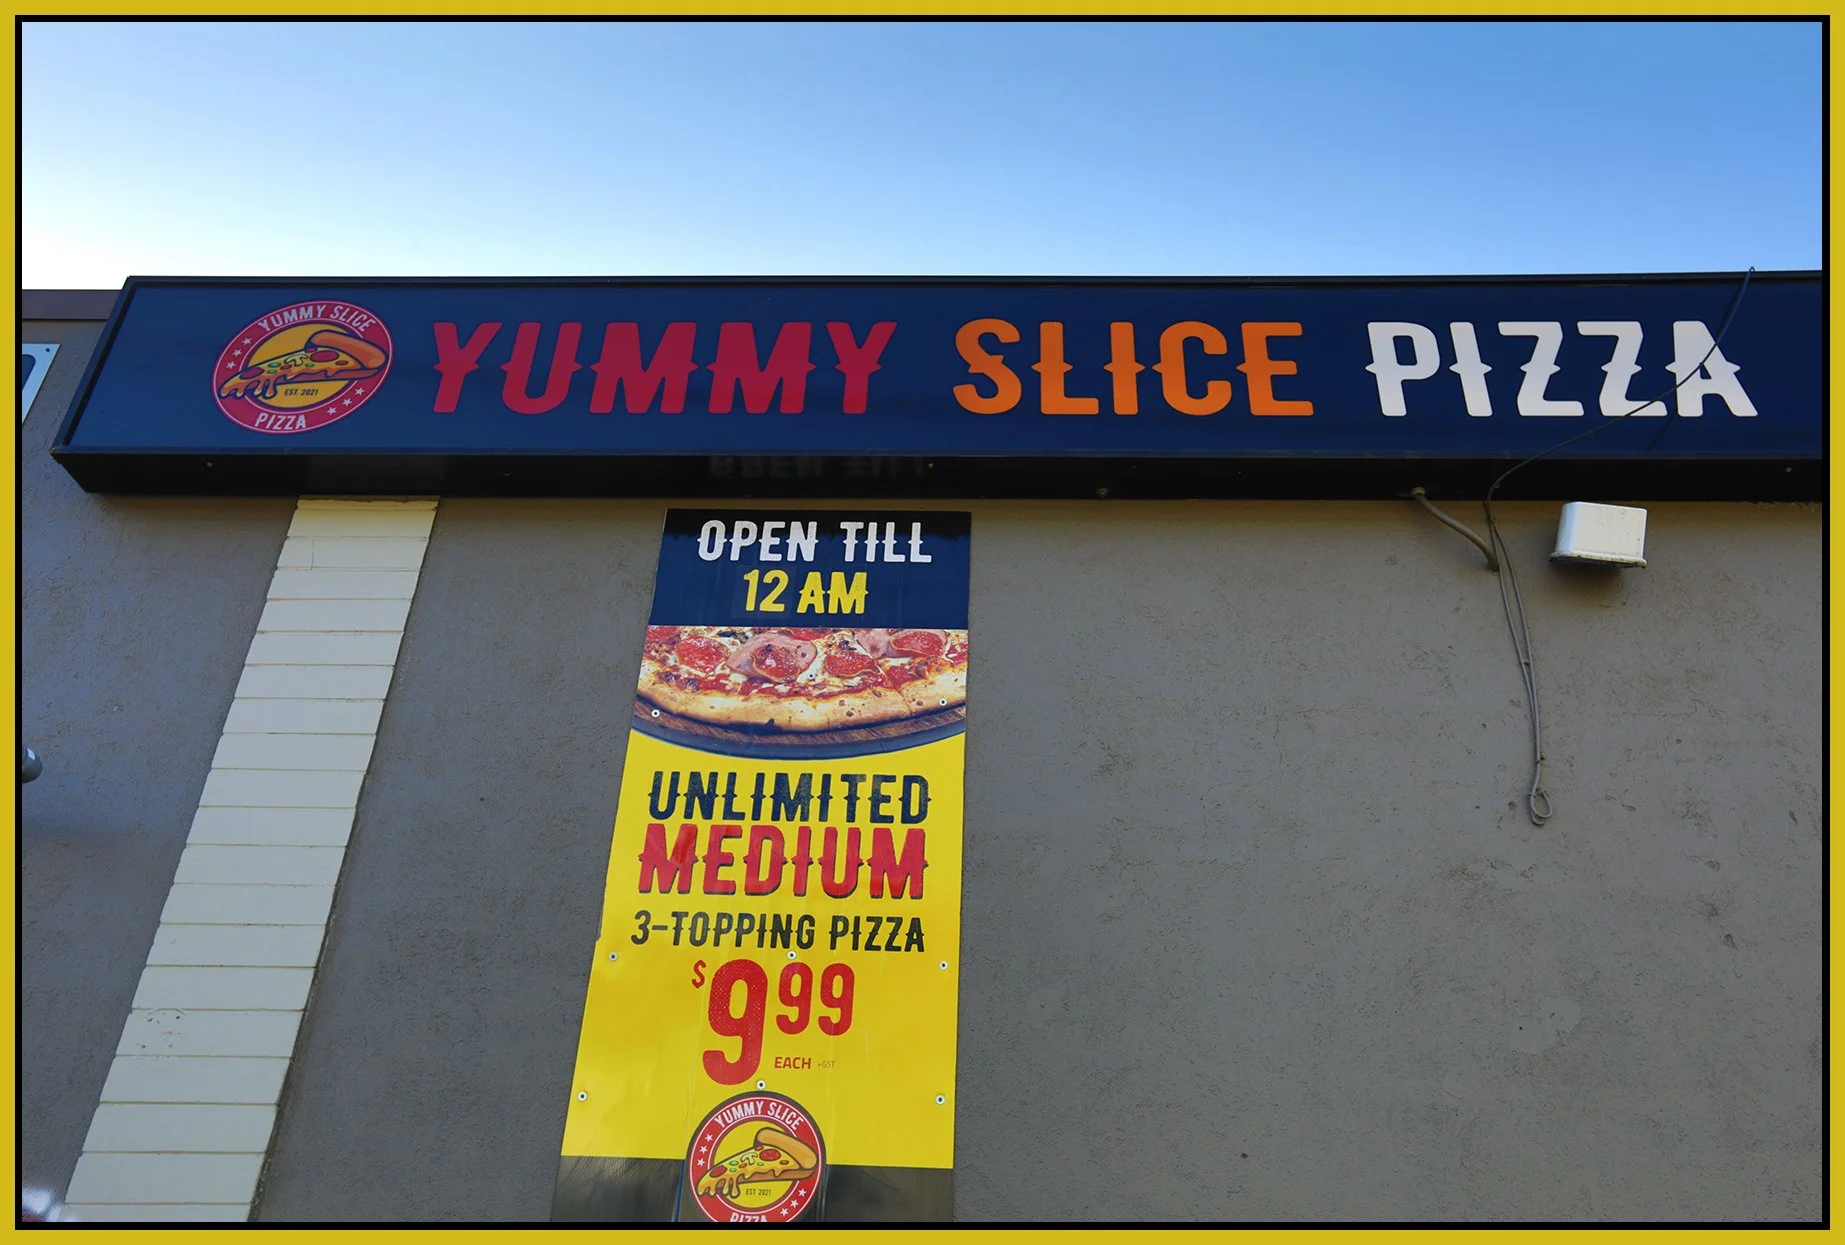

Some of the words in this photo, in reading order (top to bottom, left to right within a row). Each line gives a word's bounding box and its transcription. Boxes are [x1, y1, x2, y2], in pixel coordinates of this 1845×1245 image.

[258, 304, 327, 331] YUMMY
[330, 305, 377, 331] SLICE
[432, 322, 898, 415] YUMMY
[953, 319, 1314, 415] SLICE
[1366, 321, 1759, 418] PIZZA
[300, 388, 319, 396] 2021
[255, 413, 307, 430] PIZZA
[697, 520, 819, 561] OPEN
[840, 522, 932, 563] TILL
[743, 569, 789, 612] 12
[796, 571, 869, 614] AM
[648, 771, 932, 824] UNLIMITED
[638, 823, 929, 900] MEDIUM
[631, 910, 816, 950] 3-TOPPING
[829, 916, 925, 953] PIZZA
[774, 1056, 811, 1069] EACH
[818, 1060, 835, 1068] +GST
[714, 1101, 764, 1128] YUMMY
[767, 1102, 804, 1130] SLICE
